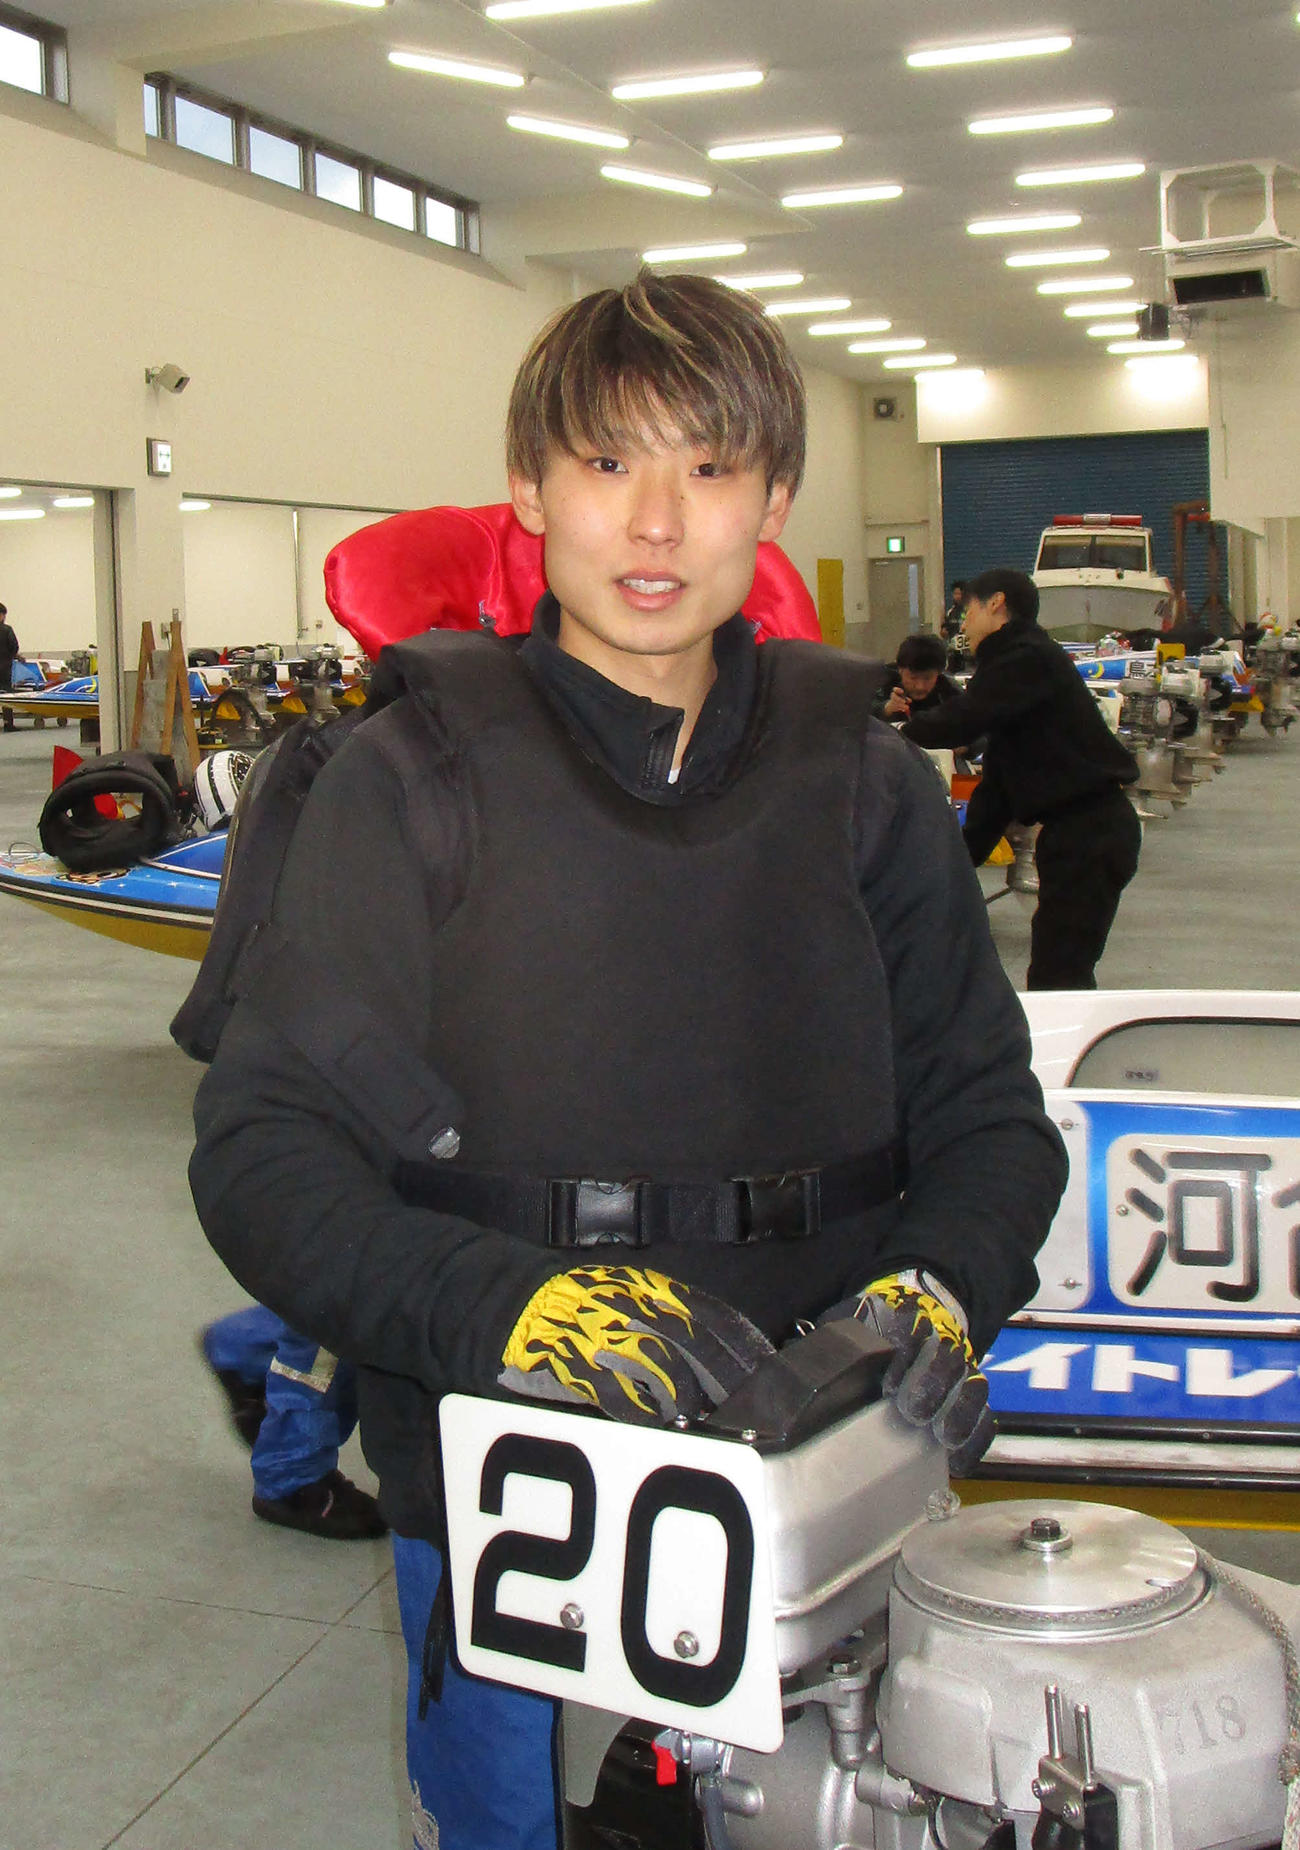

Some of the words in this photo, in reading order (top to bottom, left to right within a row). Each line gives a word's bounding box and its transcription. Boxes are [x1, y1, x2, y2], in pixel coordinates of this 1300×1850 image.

[1125, 1148, 1300, 1302] 河
[979, 1342, 1300, 1398] イトレ
[471, 1433, 755, 1708] 20
[1156, 1695, 1247, 1755] 718
